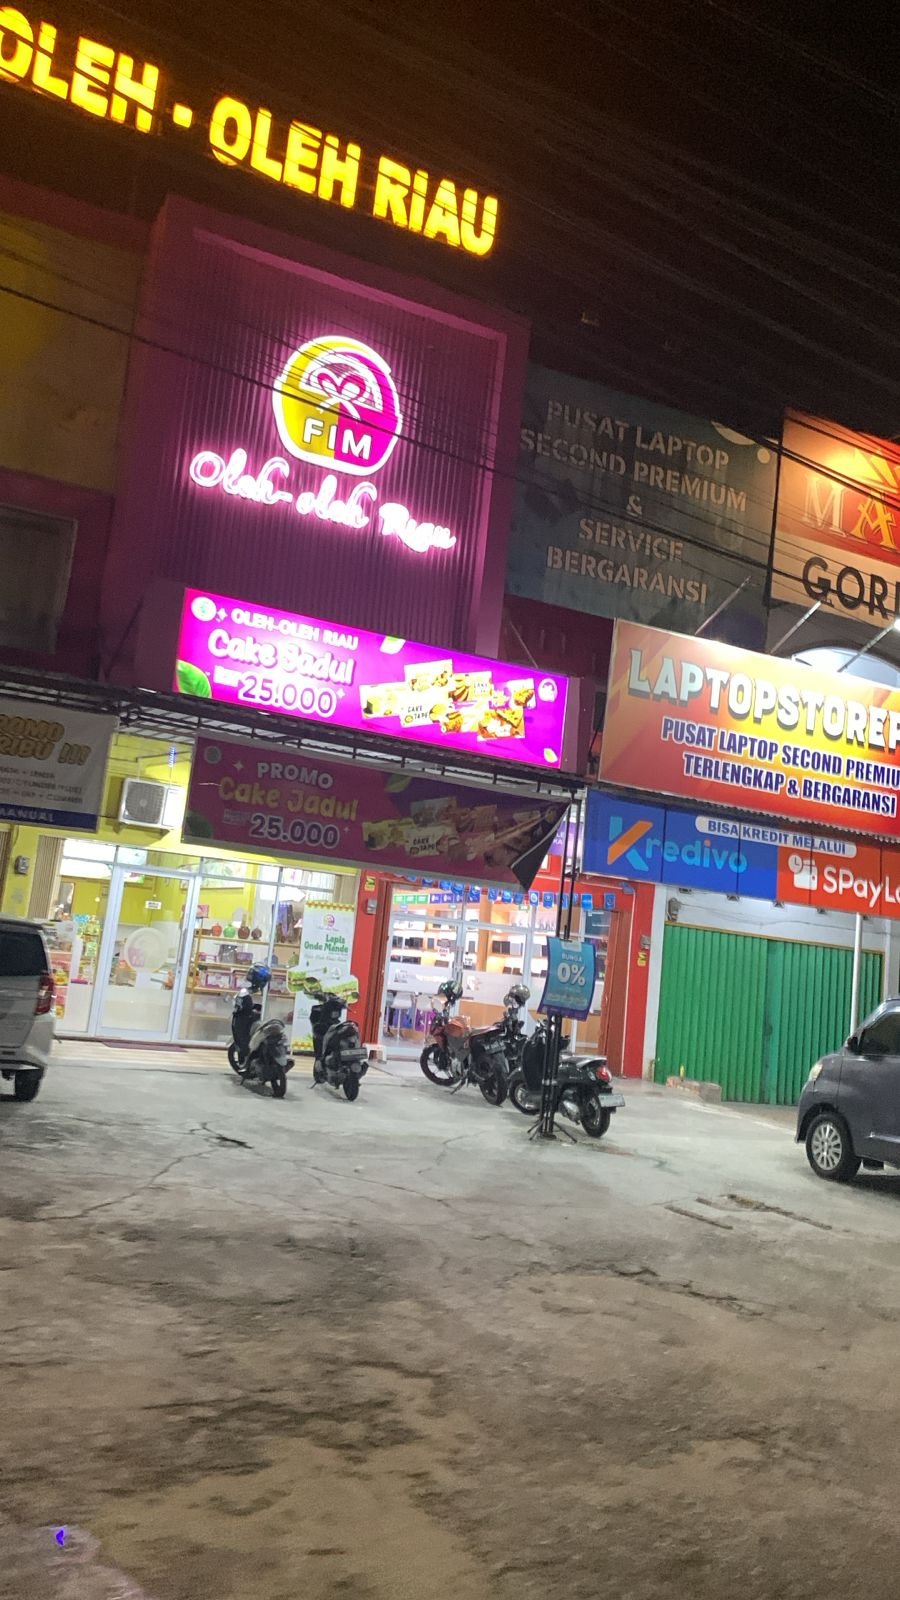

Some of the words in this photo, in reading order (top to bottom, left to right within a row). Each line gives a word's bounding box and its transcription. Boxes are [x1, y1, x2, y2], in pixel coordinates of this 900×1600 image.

[208, 96, 361, 209] OLEH
[372, 155, 498, 256] RIAU
[303, 417, 372, 460] FIM
[547, 400, 630, 442] PUSAT
[635, 425, 729, 470] LAPTOP
[520, 428, 627, 476] SECOND
[633, 460, 747, 513] PREMIUM
[626, 495, 643, 517] &
[578, 516, 684, 562] SERVICE
[546, 545, 708, 605] BERGARANSI
[802, 556, 900, 621] GOR
[208, 628, 276, 669] Cake
[322, 629, 359, 650] RIAU
[240, 672, 335, 715] 25.000
[661, 716, 717, 748] PUSAT
[718, 729, 779, 762] LAPTOP
[782, 743, 842, 777] SECOND
[218, 776, 281, 808] Cake
[287, 789, 359, 822] Jadul
[257, 762, 333, 790] PROMO
[683, 752, 785, 793] TERLENGKAP
[787, 778, 799, 795] &
[802, 778, 897, 816] BERGARANSI
[250, 812, 340, 849] 25.000
[607, 815, 747, 873] Kredivo
[707, 820, 739, 836] BISA
[742, 824, 788, 846] KREDIT
[792, 834, 846, 856] MELALUI
[557, 962, 585, 987] 0%
